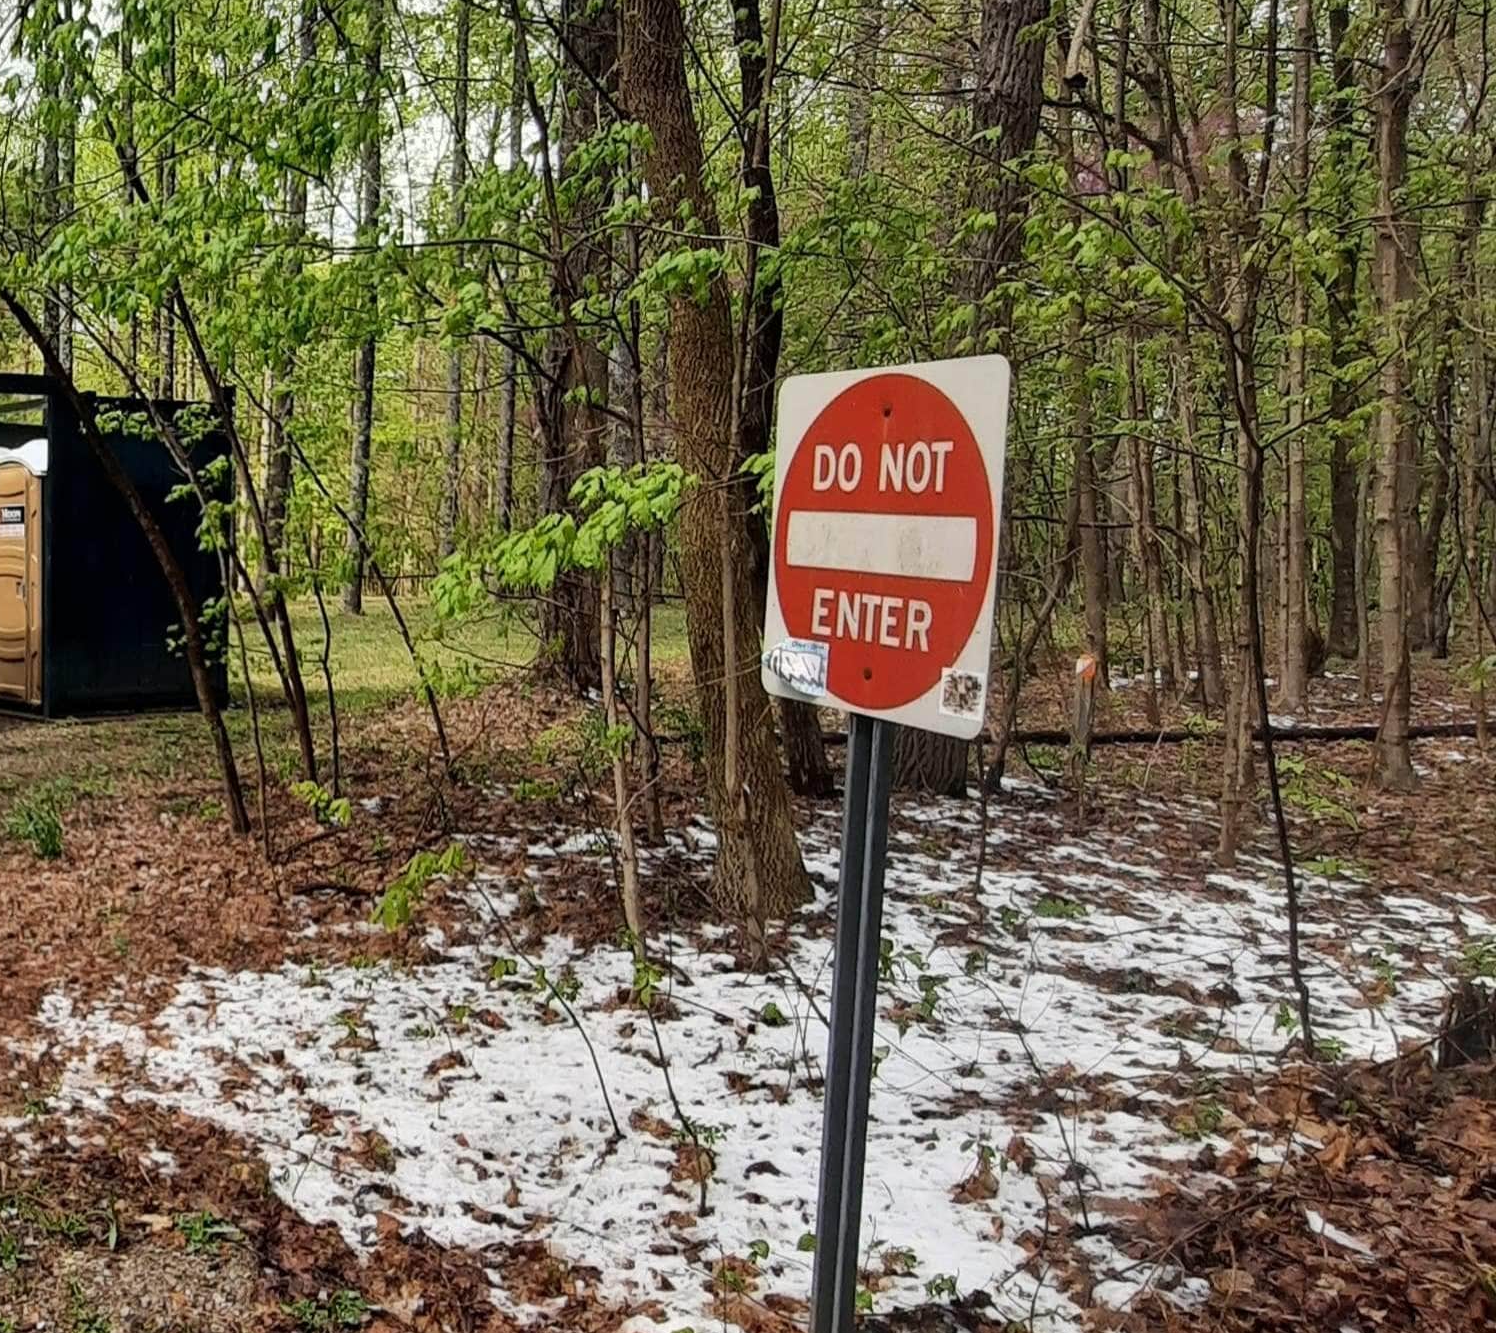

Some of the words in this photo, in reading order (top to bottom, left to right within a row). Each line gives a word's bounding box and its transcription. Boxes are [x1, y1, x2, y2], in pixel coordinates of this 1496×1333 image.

[813, 443, 862, 492] DO
[879, 441, 954, 494] NOT
[811, 587, 933, 653] ENTER
